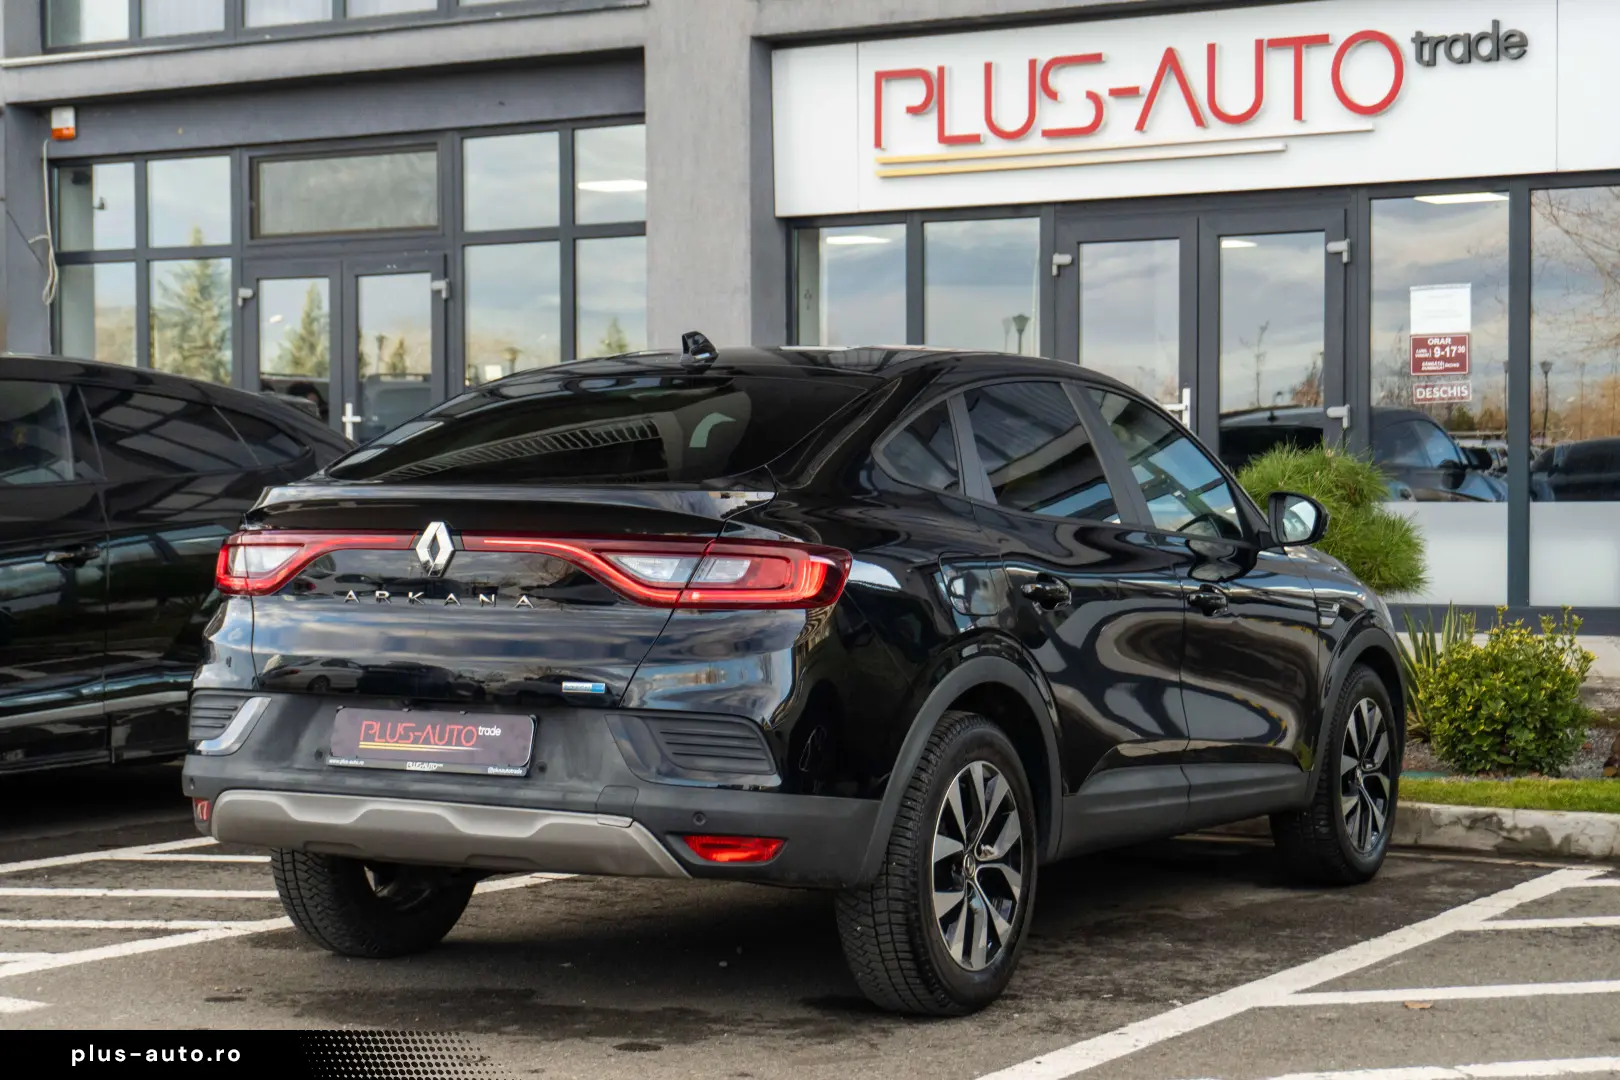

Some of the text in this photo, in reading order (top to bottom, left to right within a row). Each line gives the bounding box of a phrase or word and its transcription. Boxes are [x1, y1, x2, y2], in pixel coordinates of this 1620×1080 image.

[874, 20, 1528, 149] PLUS-AUTO trade
[1416, 385, 1469, 399] DESCHIS
[343, 589, 535, 609] ARKANA
[359, 720, 502, 747] PLUS-AUTO trade
